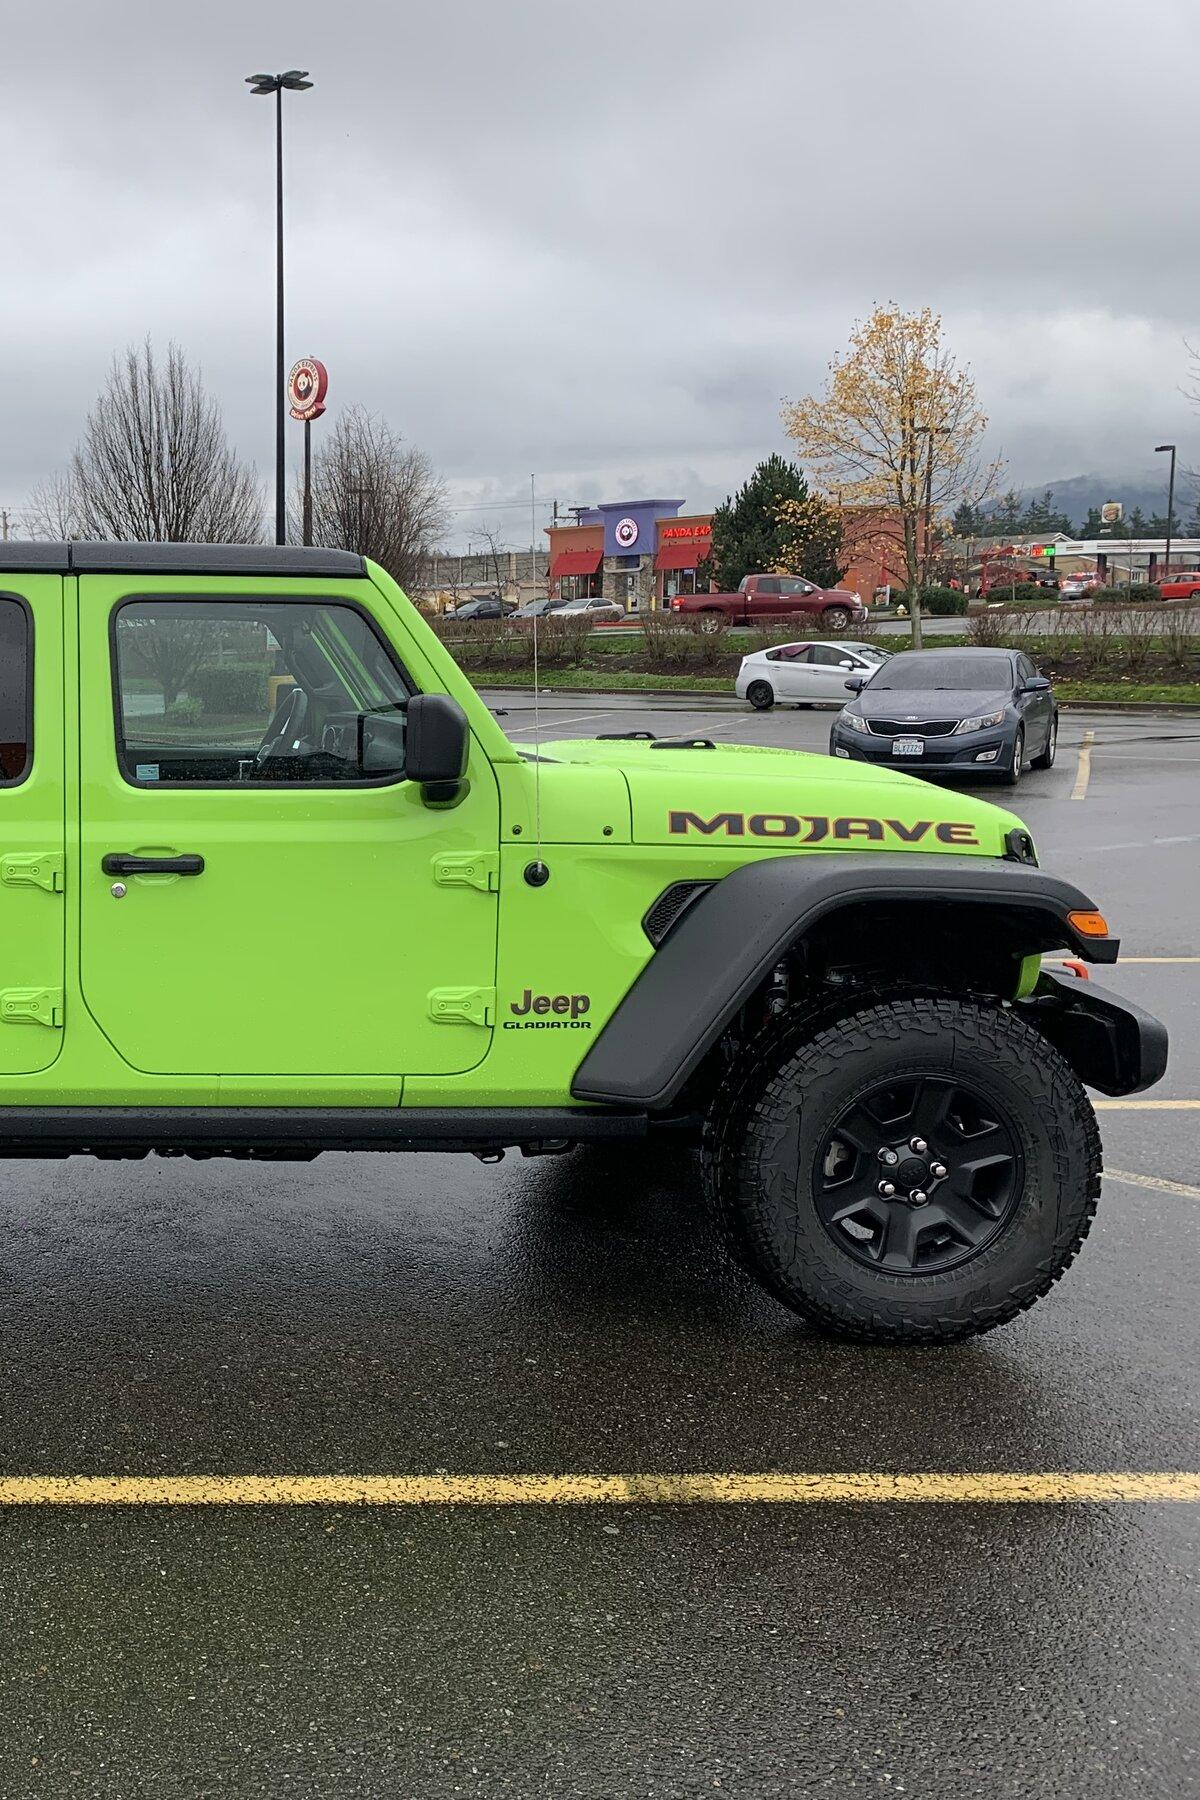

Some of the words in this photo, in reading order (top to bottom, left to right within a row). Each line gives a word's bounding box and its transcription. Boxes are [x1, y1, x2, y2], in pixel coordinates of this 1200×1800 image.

[289, 364, 301, 387] PANDA
[663, 527, 692, 538] PANDA
[694, 526, 711, 535] EXP
[668, 810, 980, 845] MOJAVE
[510, 989, 591, 1019] Jeep
[503, 1021, 592, 1030] GLADIATOR
